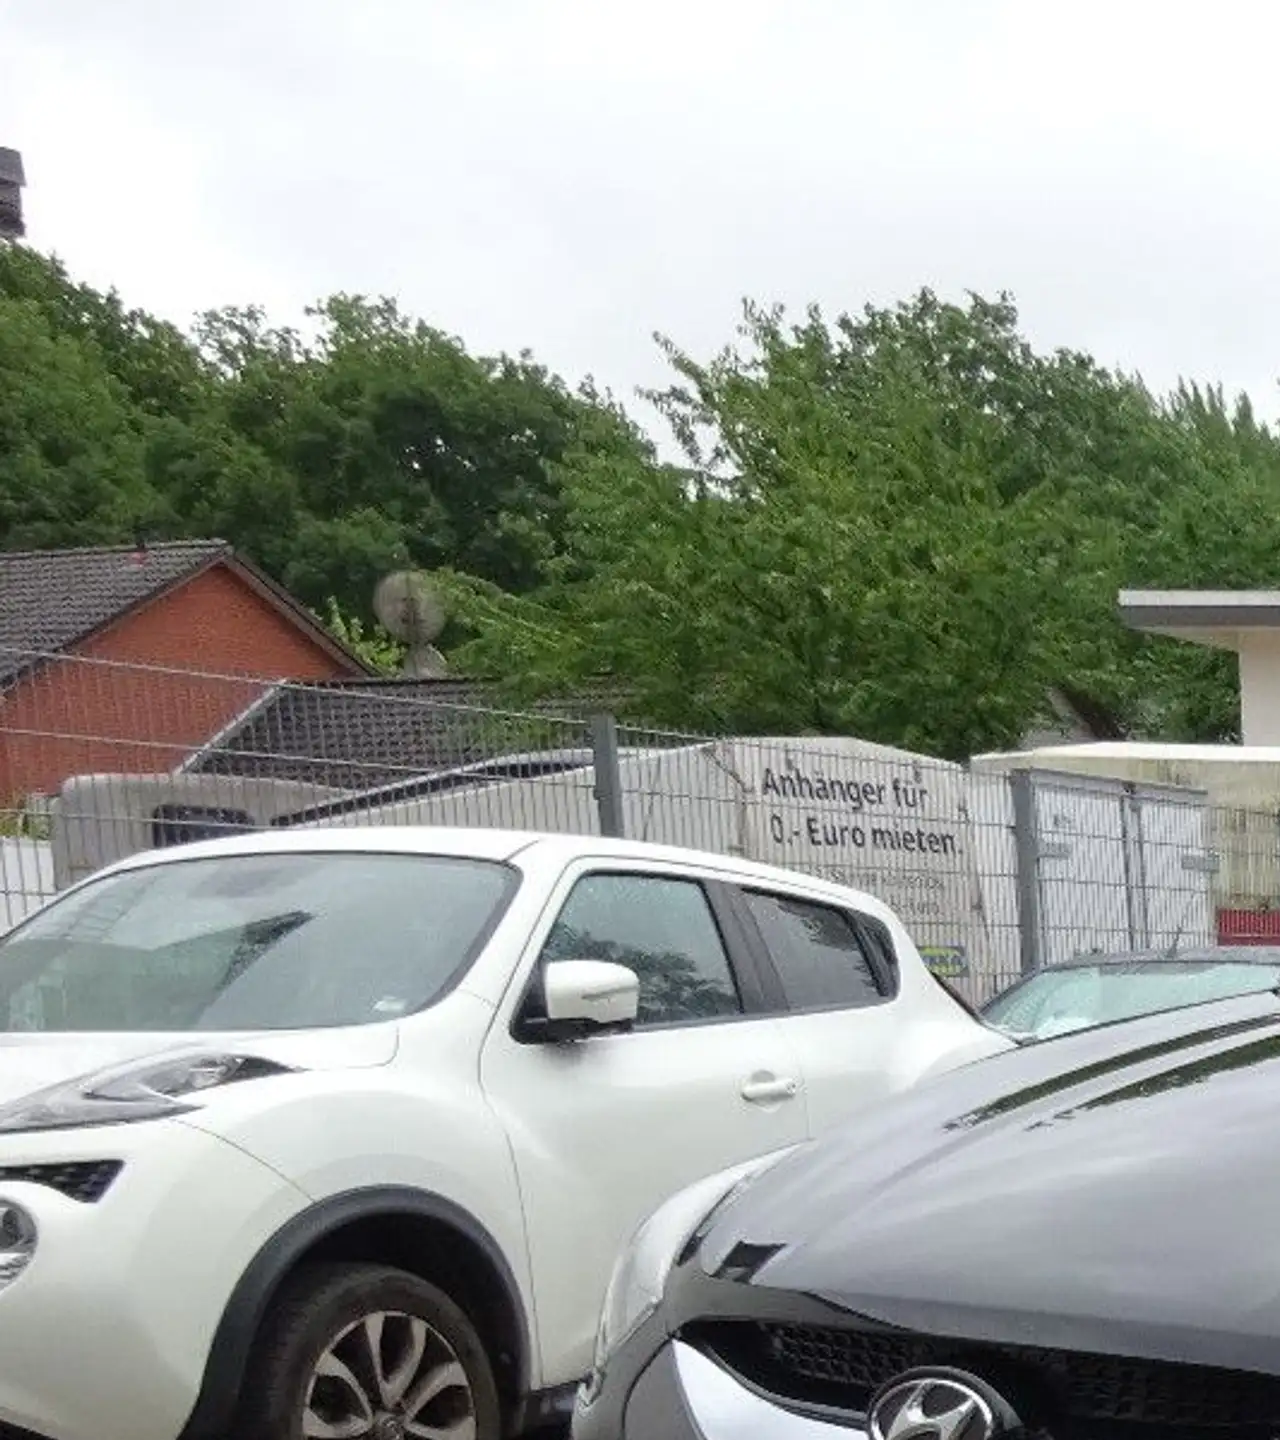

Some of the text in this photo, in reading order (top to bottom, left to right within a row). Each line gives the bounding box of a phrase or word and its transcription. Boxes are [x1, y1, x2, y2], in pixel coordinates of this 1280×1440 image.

[763, 767, 928, 811] Anhänger für
[806, 817, 865, 847] Euro
[871, 823, 964, 855] mieten.
